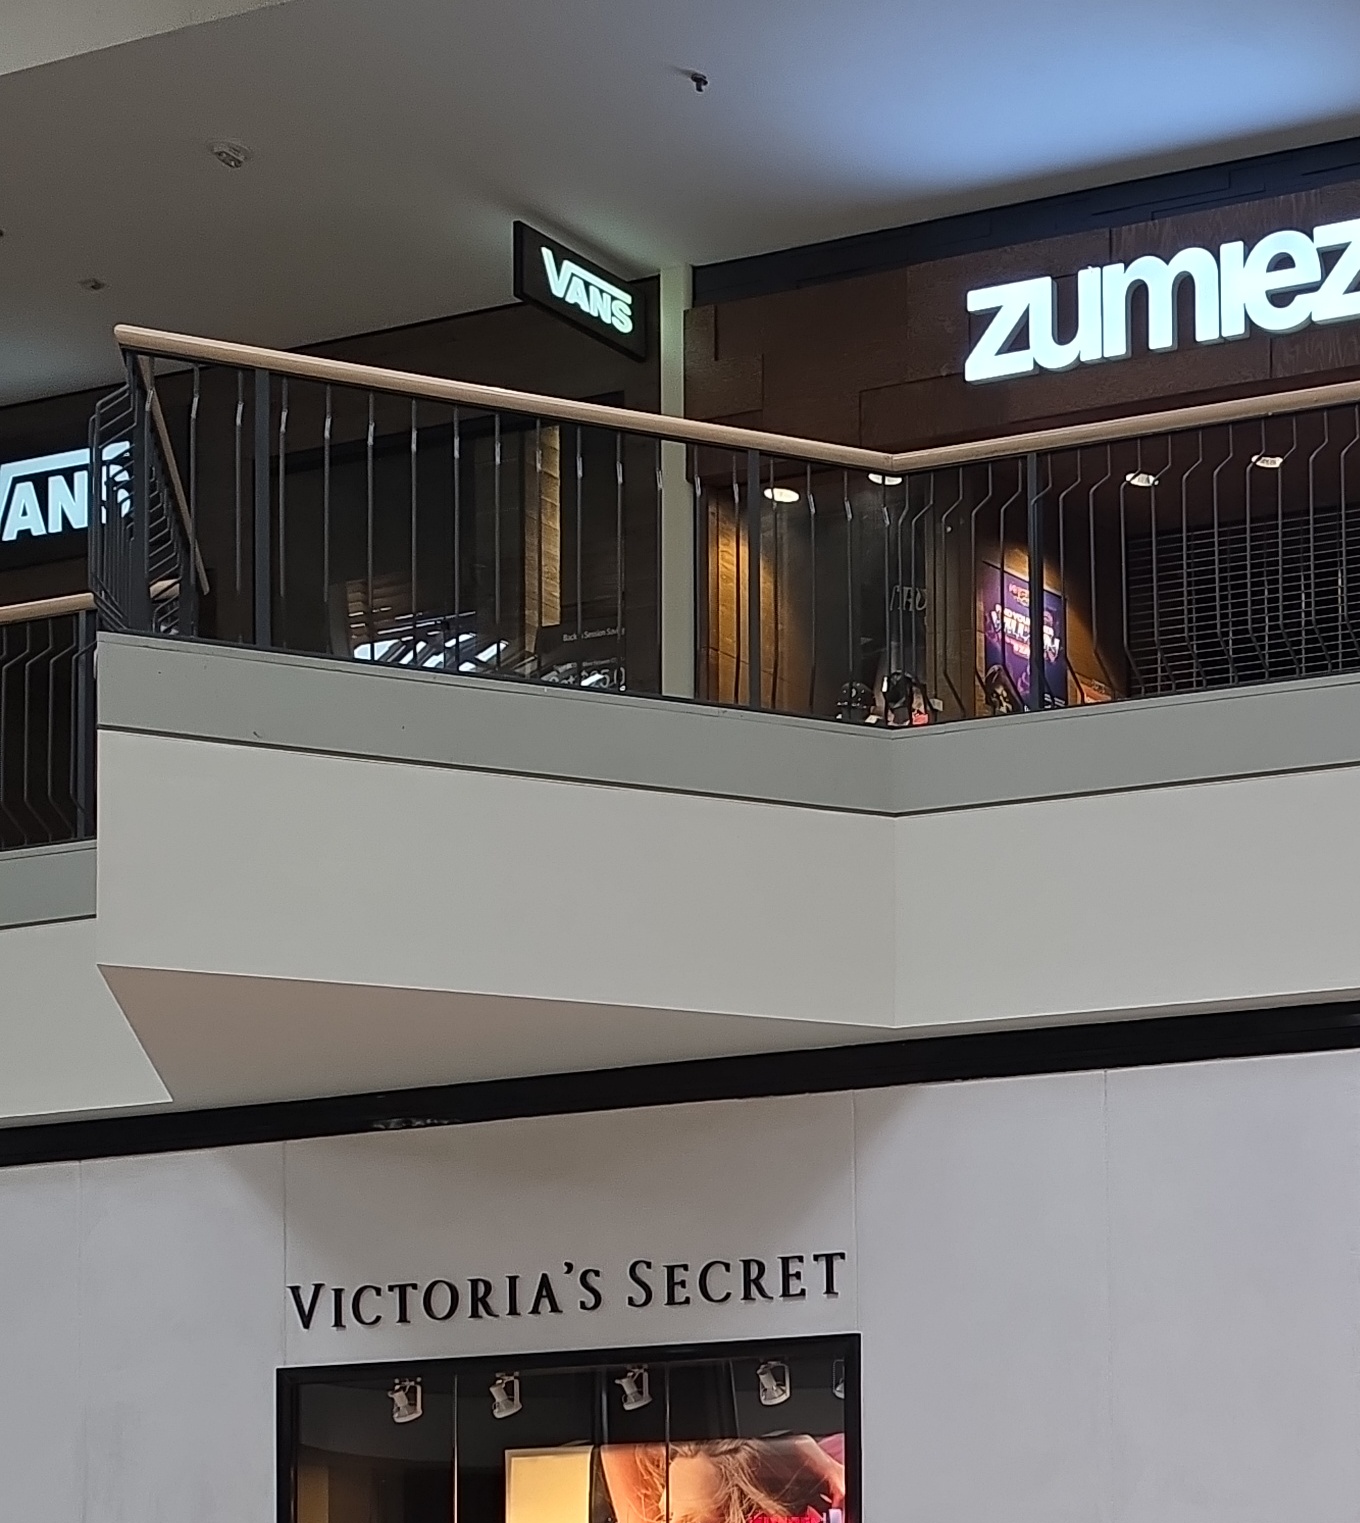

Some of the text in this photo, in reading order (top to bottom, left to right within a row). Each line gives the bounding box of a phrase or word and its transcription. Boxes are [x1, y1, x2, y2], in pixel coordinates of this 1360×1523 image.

[541, 246, 633, 333] VANS
[287, 1252, 846, 1330] VICTORIA'S SECRET
